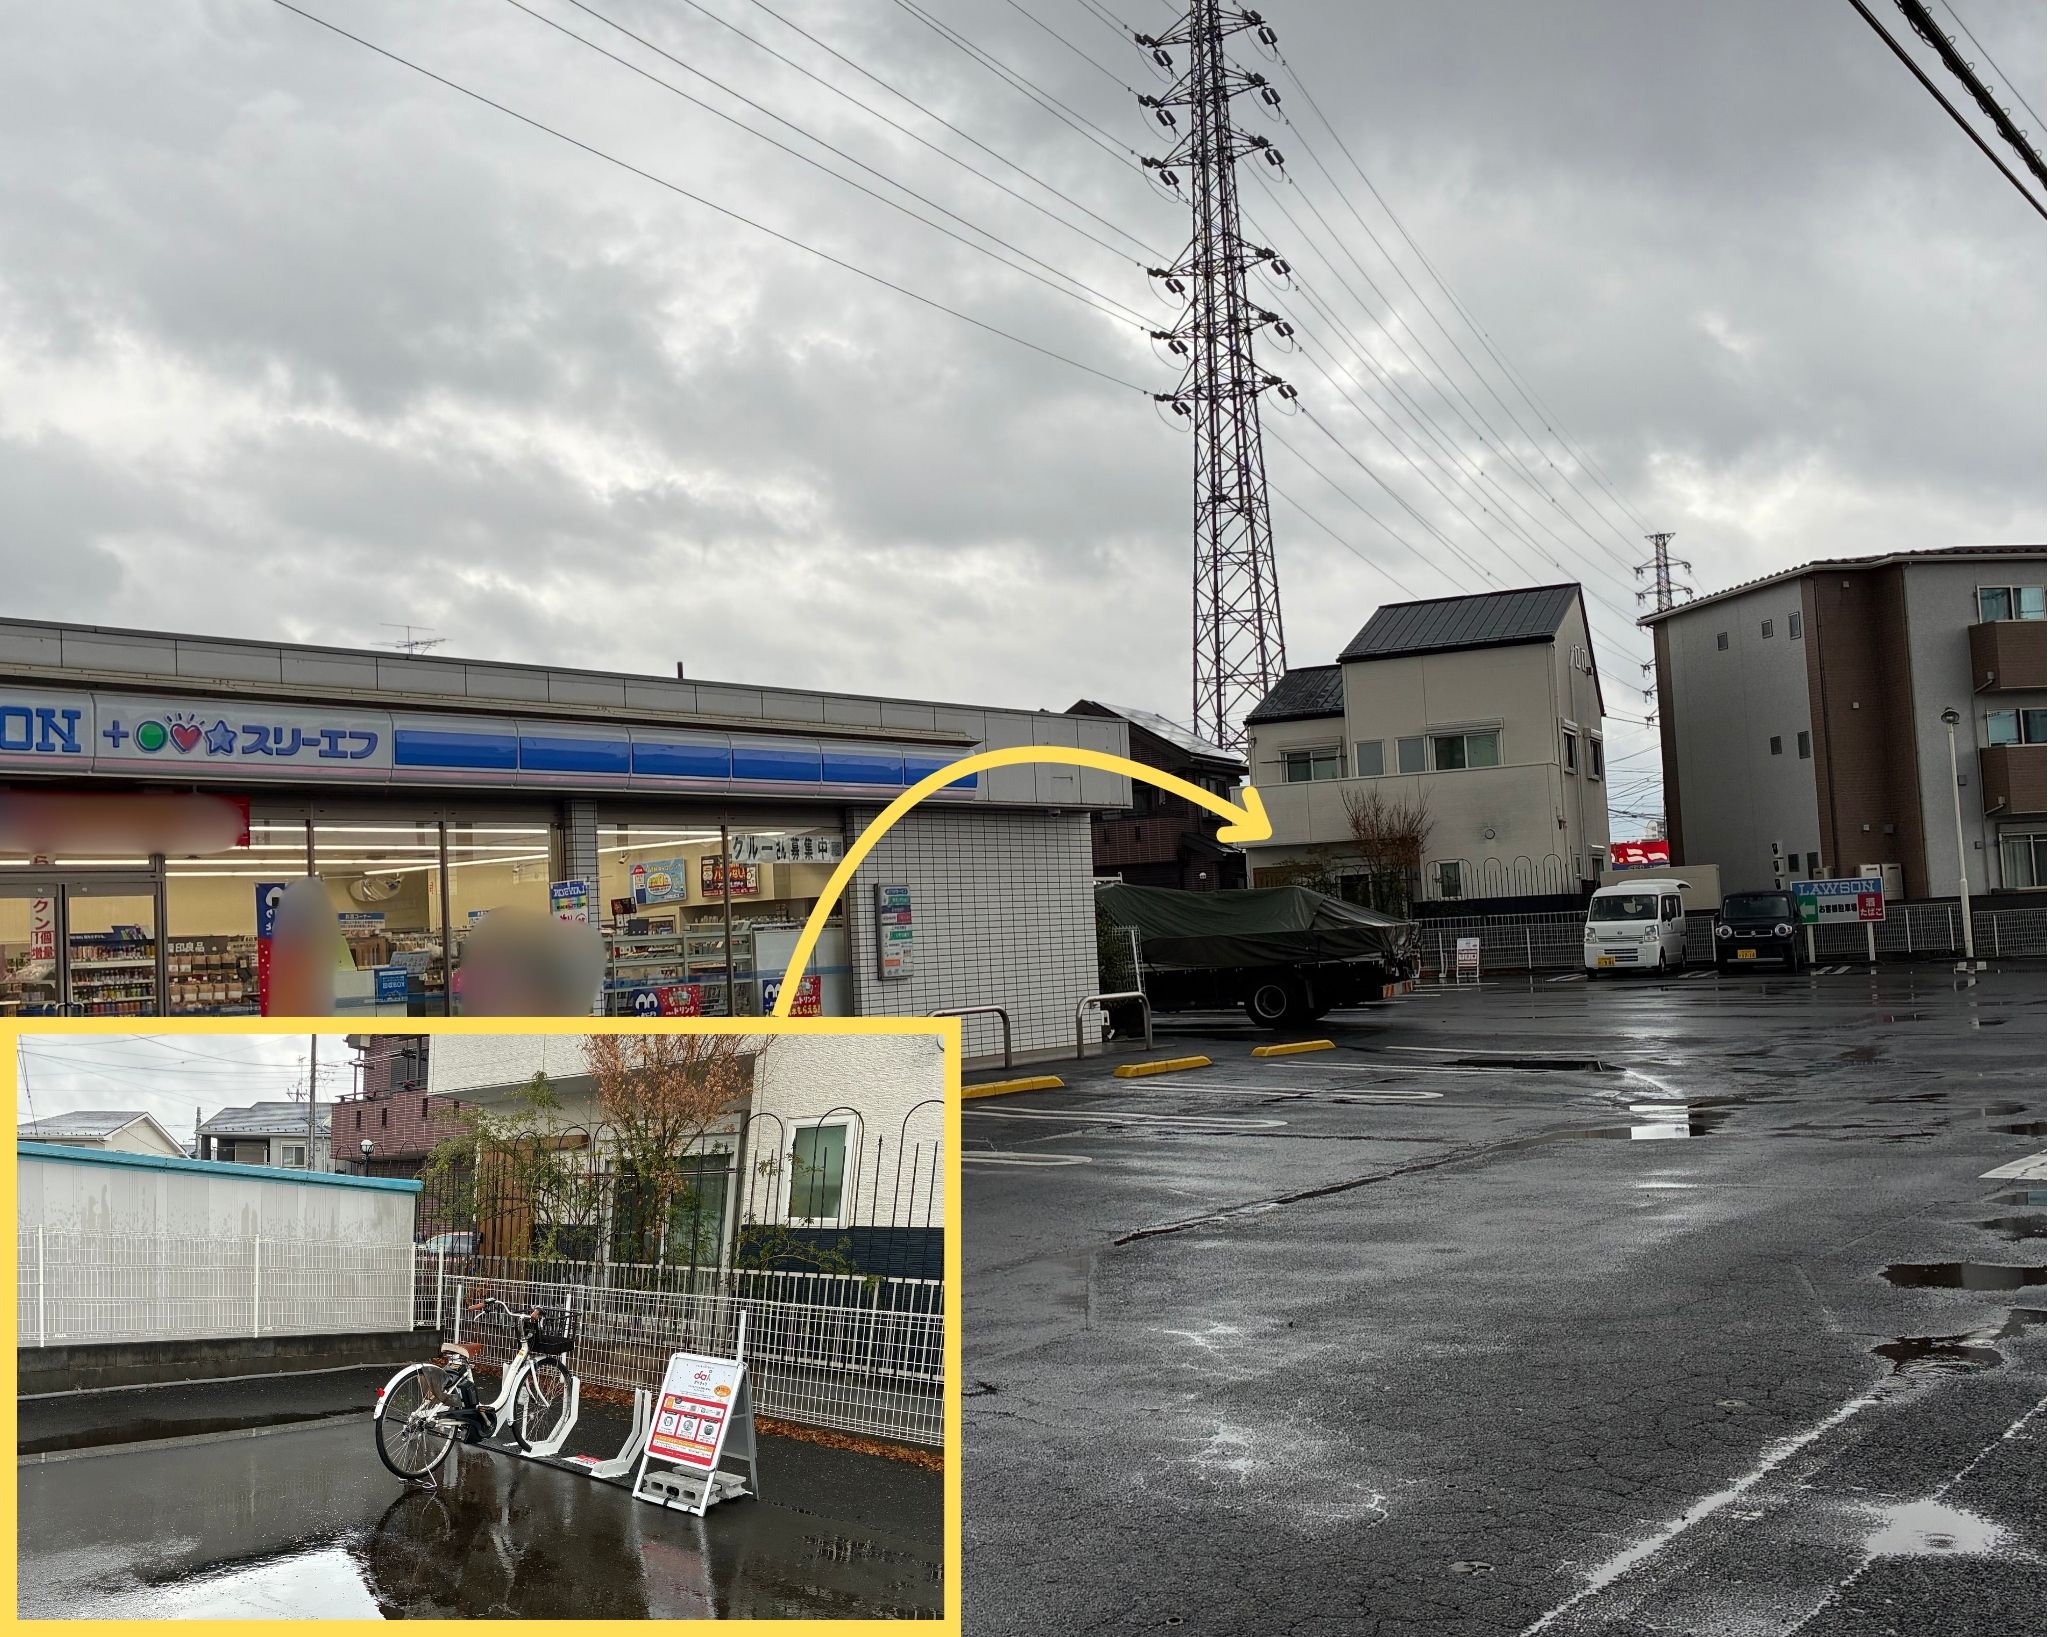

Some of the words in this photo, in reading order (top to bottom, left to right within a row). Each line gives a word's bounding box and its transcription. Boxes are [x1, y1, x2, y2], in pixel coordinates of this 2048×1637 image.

[242, 725, 379, 759] スリーエフ
[1799, 881, 1875, 896] LAWSON
[1860, 907, 1882, 916] たばこ
